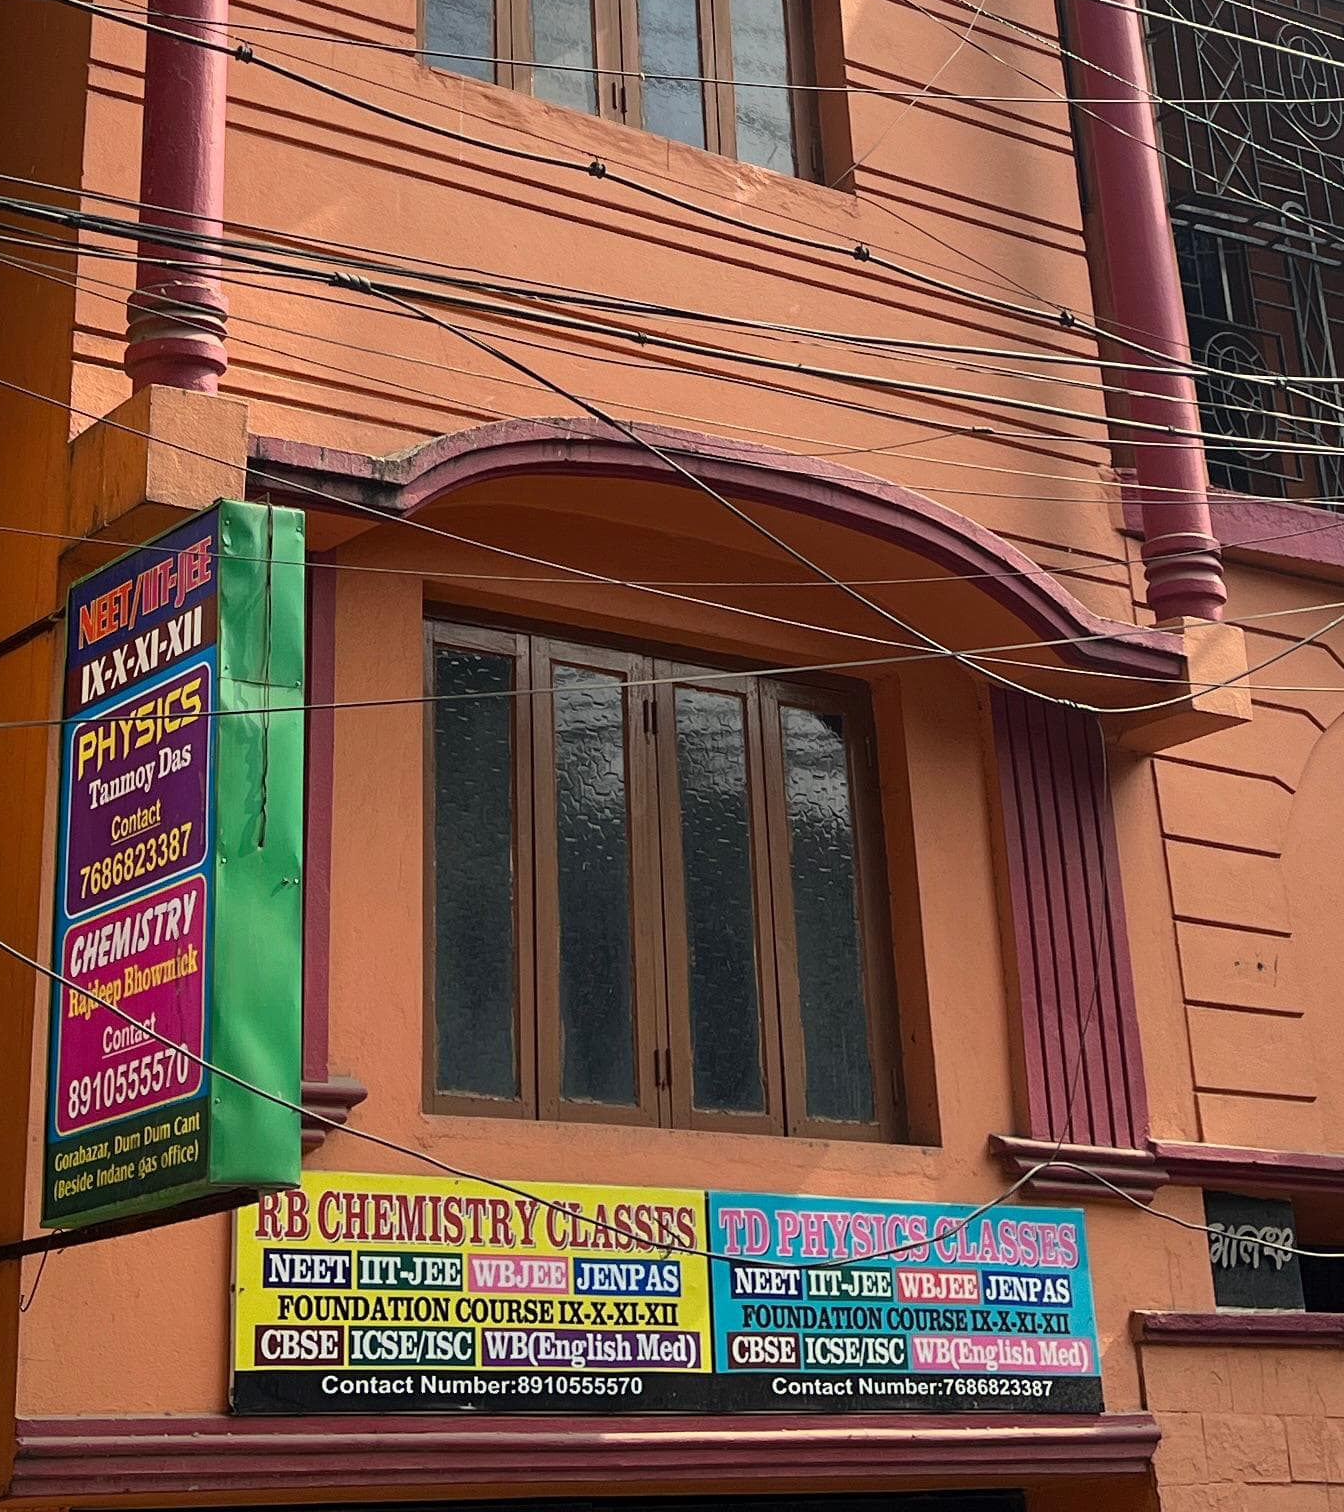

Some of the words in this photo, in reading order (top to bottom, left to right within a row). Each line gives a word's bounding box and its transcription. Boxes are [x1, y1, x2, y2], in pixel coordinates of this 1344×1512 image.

[78, 535, 212, 650] NEET/IIT-JEE
[81, 605, 203, 704] IX-X-XI-XII
[78, 677, 202, 781] PHYSICS
[89, 760, 156, 810] Tanmoy
[158, 743, 192, 779] Das
[111, 799, 161, 841] Contact
[80, 822, 193, 899] 7686823387
[70, 890, 197, 978] CHEMISTRY
[68, 978, 122, 1020] Rajdeep
[123, 943, 199, 998] Bhowmick
[103, 1012, 157, 1054] Contact
[68, 1043, 189, 1119] 8910555570
[54, 1172, 94, 1202] (Beside
[96, 1161, 135, 1187] Indane
[138, 1155, 158, 1179] gas
[161, 1139, 199, 1169] office)
[55, 1141, 111, 1172] Gorabazar,
[114, 1132, 141, 1155] Dum
[144, 1121, 171, 1146] Dum
[174, 1112, 201, 1136] Cant
[255, 1190, 309, 1241] RB
[317, 1191, 539, 1248] CHEMISTRY
[545, 1199, 698, 1254] CLASSES
[719, 1208, 771, 1256] TD
[775, 1210, 929, 1262] PHYSICS
[934, 1216, 1079, 1268] CLASSES
[268, 1253, 350, 1284] NEET
[359, 1256, 461, 1287] IIT-JEE
[471, 1259, 567, 1289] WBJEE
[576, 1262, 679, 1293] JENPAS
[734, 1267, 800, 1295] NEET
[808, 1270, 892, 1297] IIT-JEE
[898, 1272, 978, 1300] WBJEE
[986, 1275, 1070, 1304] JENPAS
[278, 1294, 451, 1322] FOUNDATION
[455, 1298, 555, 1324] COURSE
[559, 1300, 679, 1326] IX-X-XI-XII
[742, 1304, 883, 1330] FOUNDATION
[886, 1308, 968, 1331] COURSE
[970, 1310, 1070, 1334] IX-X-XI-XII
[260, 1329, 339, 1360] CBSE
[351, 1330, 473, 1363] ICSE/ISC
[484, 1331, 633, 1368] WB(English
[636, 1333, 697, 1368] Med)
[732, 1336, 796, 1363] CBSE
[805, 1337, 905, 1367] ICSE/ISC
[913, 1338, 1037, 1370] WB(English
[1038, 1341, 1089, 1372] Med)
[321, 1375, 414, 1395] Contact
[421, 1375, 643, 1395] Number:8910555570
[772, 1377, 853, 1396] Contact
[859, 1377, 1053, 1397] Number:7686823387
